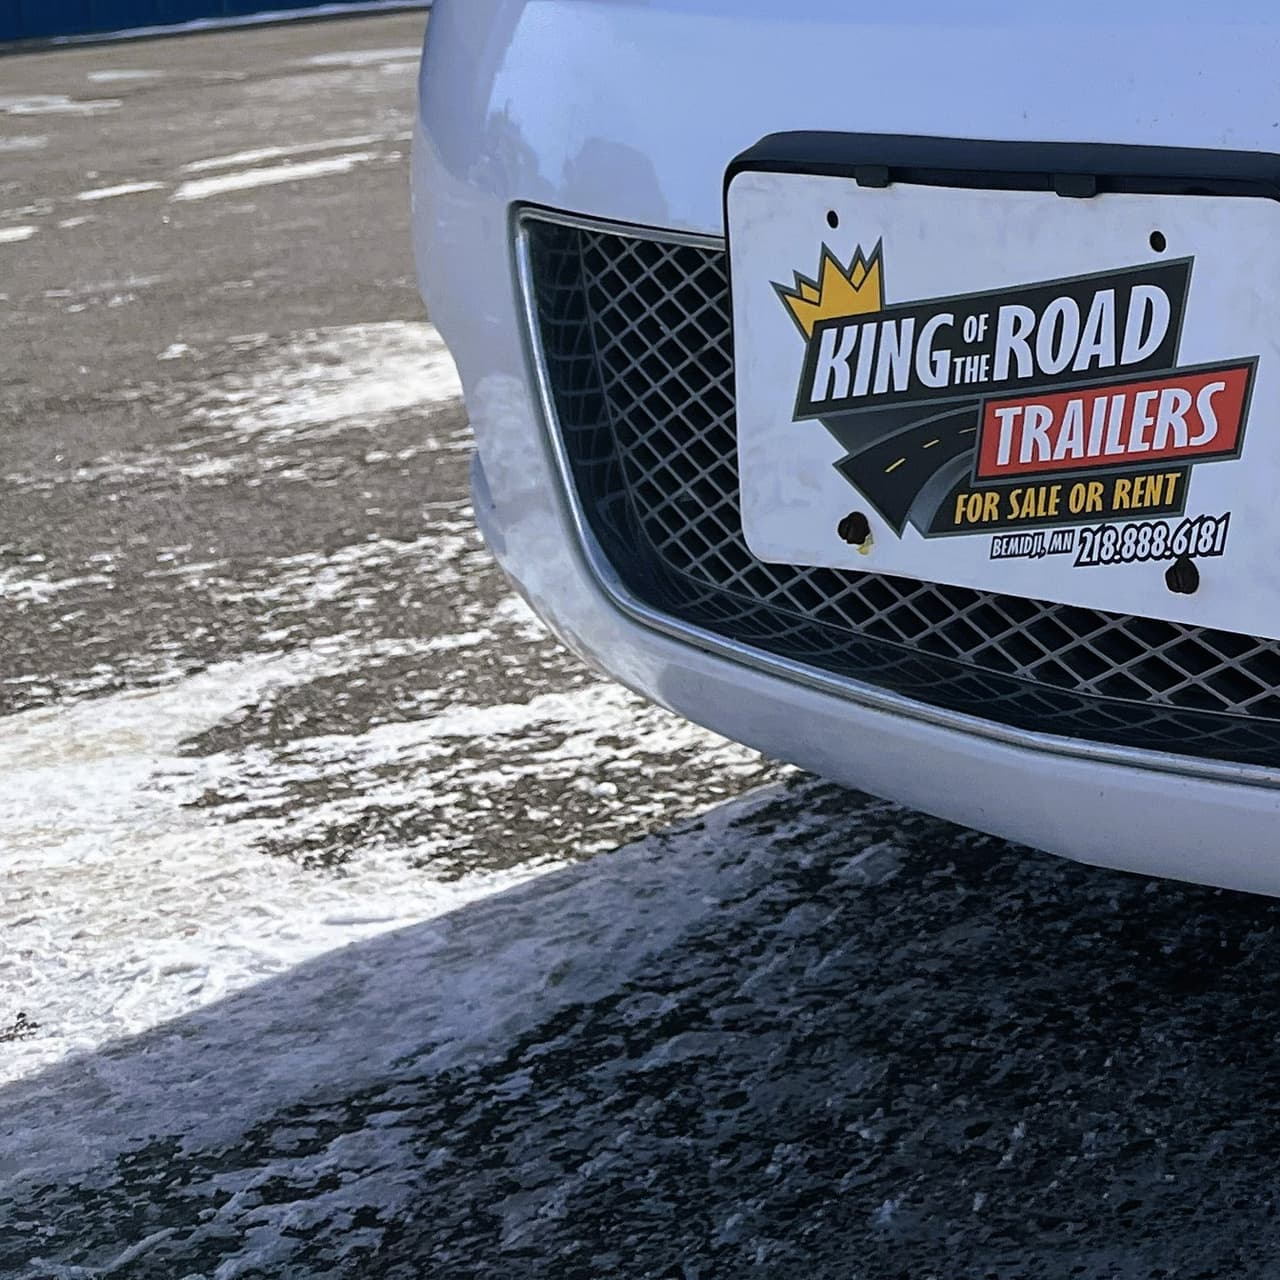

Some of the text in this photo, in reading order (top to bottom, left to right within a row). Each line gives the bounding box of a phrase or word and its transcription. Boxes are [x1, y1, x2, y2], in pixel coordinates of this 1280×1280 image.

[810, 284, 1171, 403] KING OF THE ROAD
[995, 381, 1226, 466] TRAILERS
[954, 472, 1182, 525] FOR SALE OR RENT
[991, 516, 1229, 565] BEMIDJI, MN 218.888.6181
